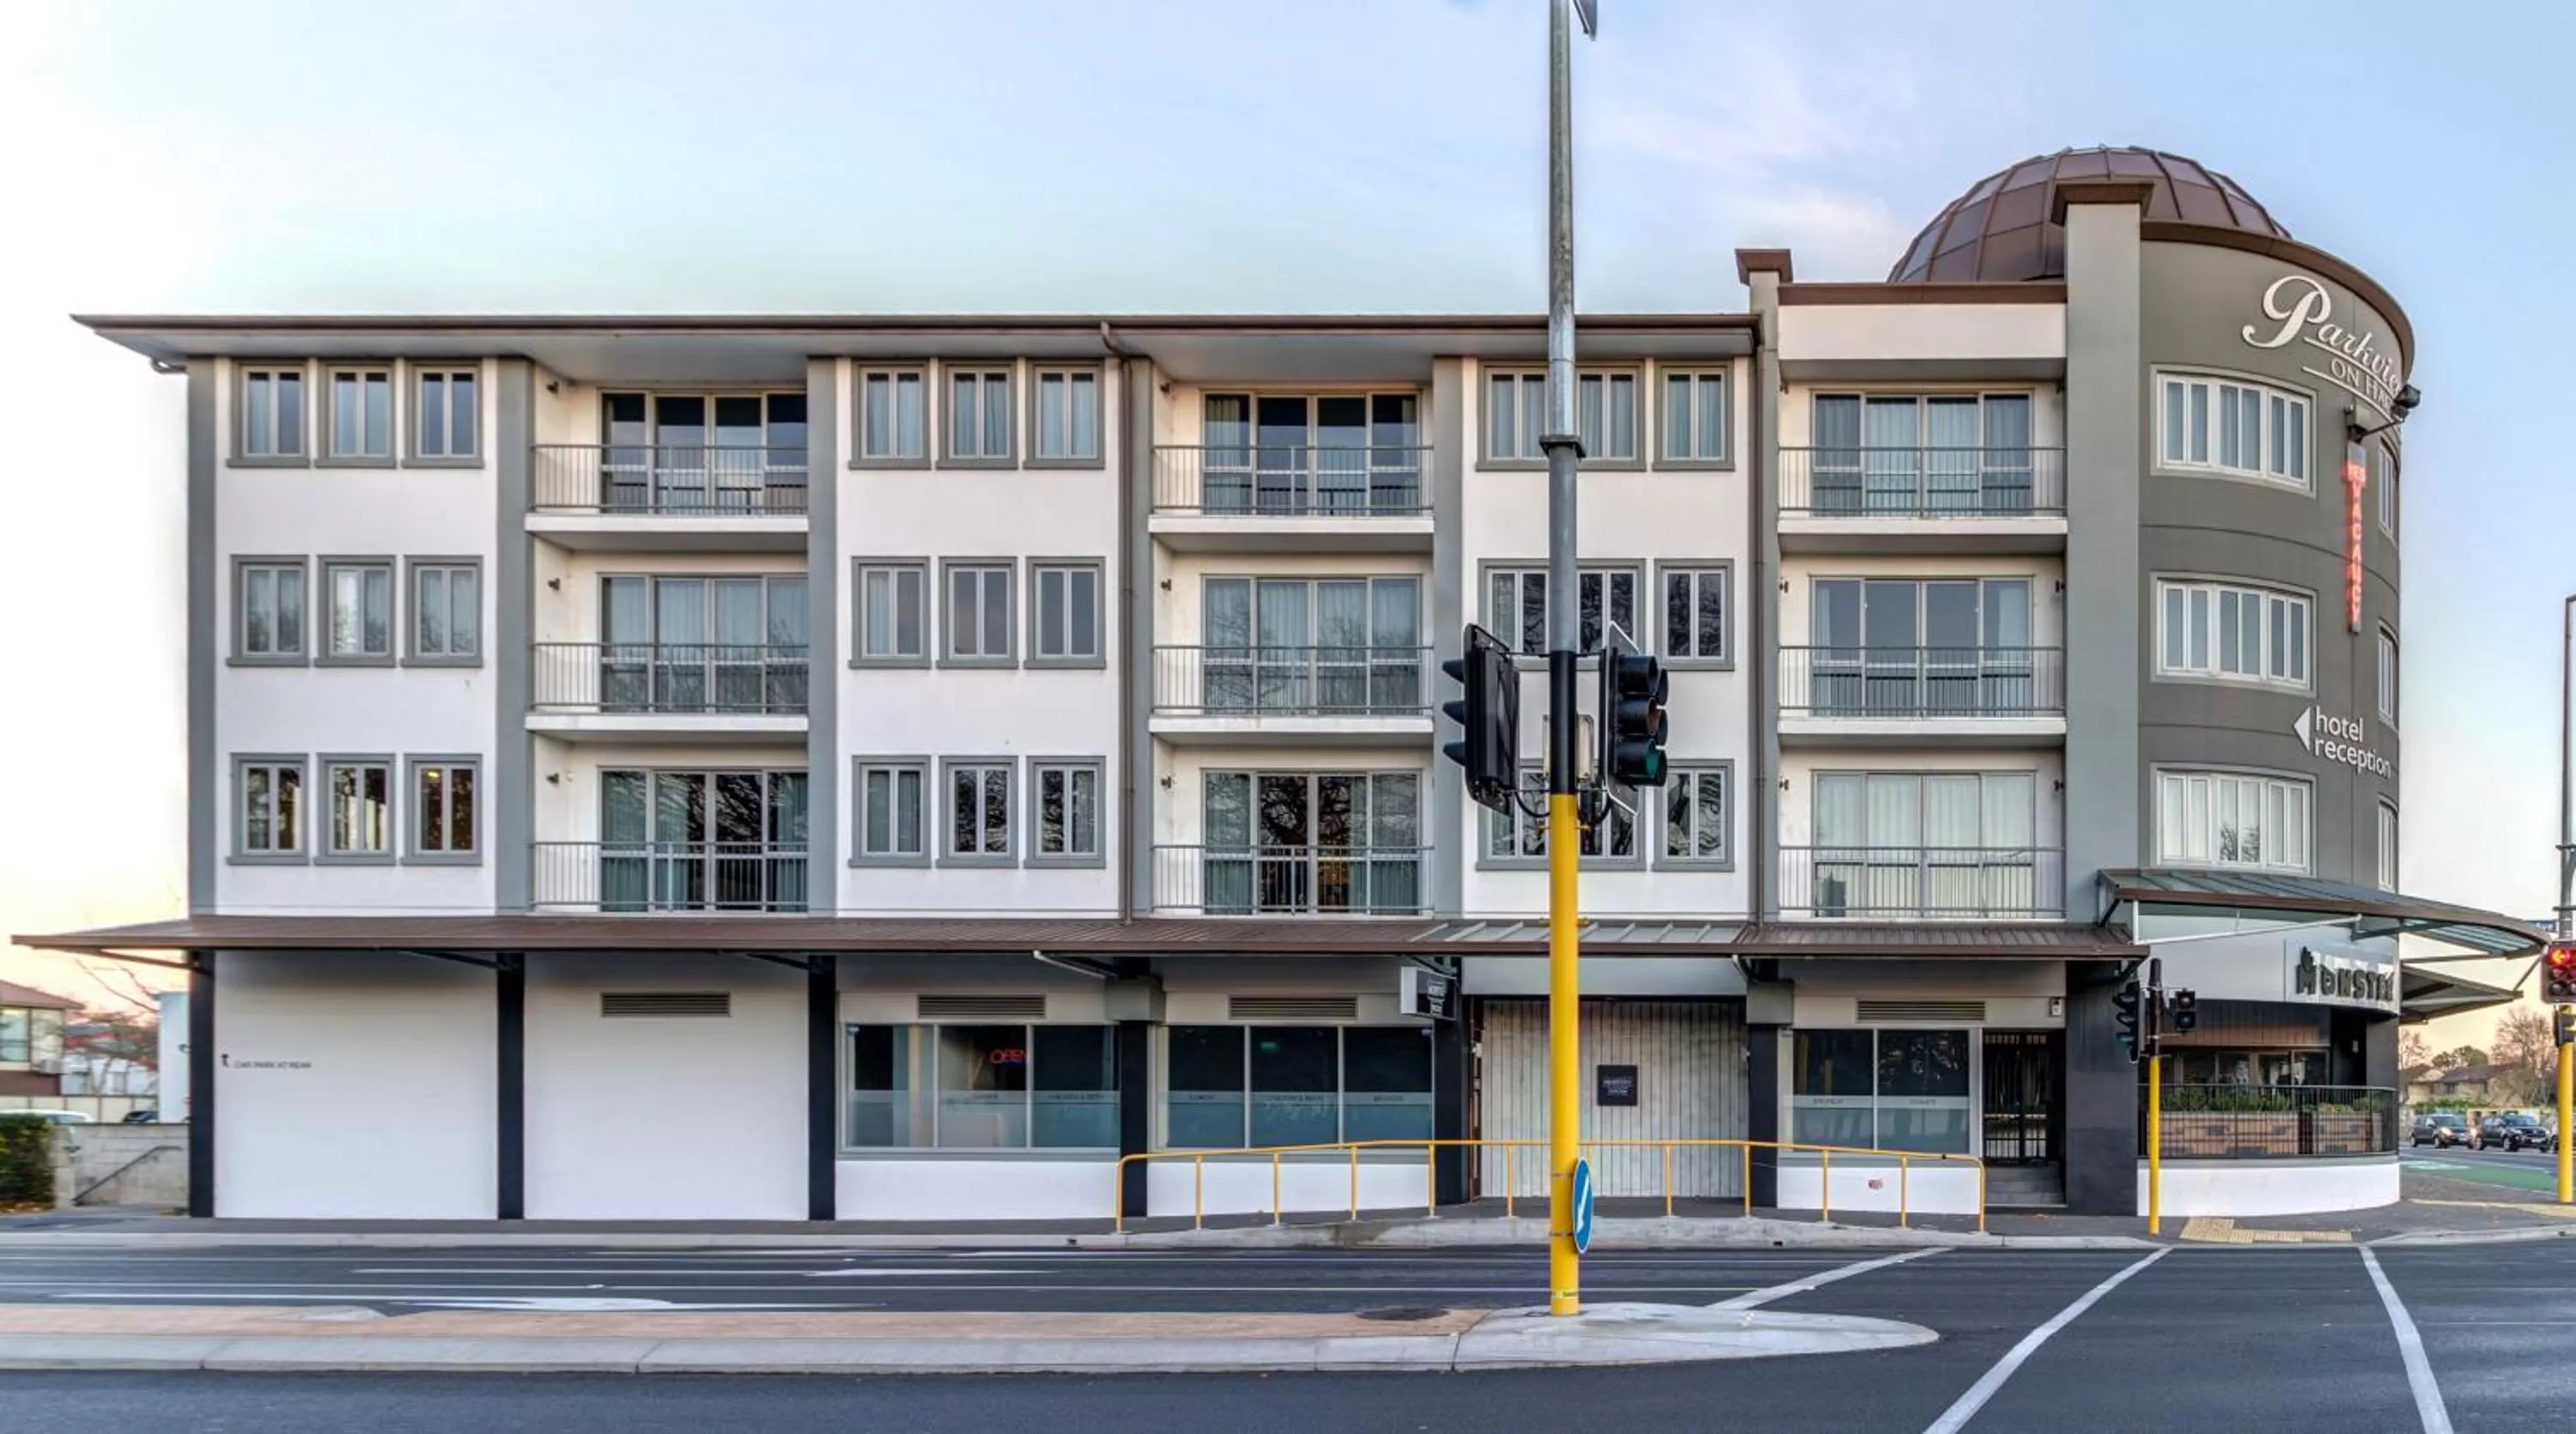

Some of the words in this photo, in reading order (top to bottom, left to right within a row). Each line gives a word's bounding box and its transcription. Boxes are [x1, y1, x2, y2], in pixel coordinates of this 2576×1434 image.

[2331, 359, 2360, 386] ON
[2351, 481, 2363, 623] VACANCY
[2316, 705, 2364, 742] hotel
[2314, 738, 2391, 779] reception
